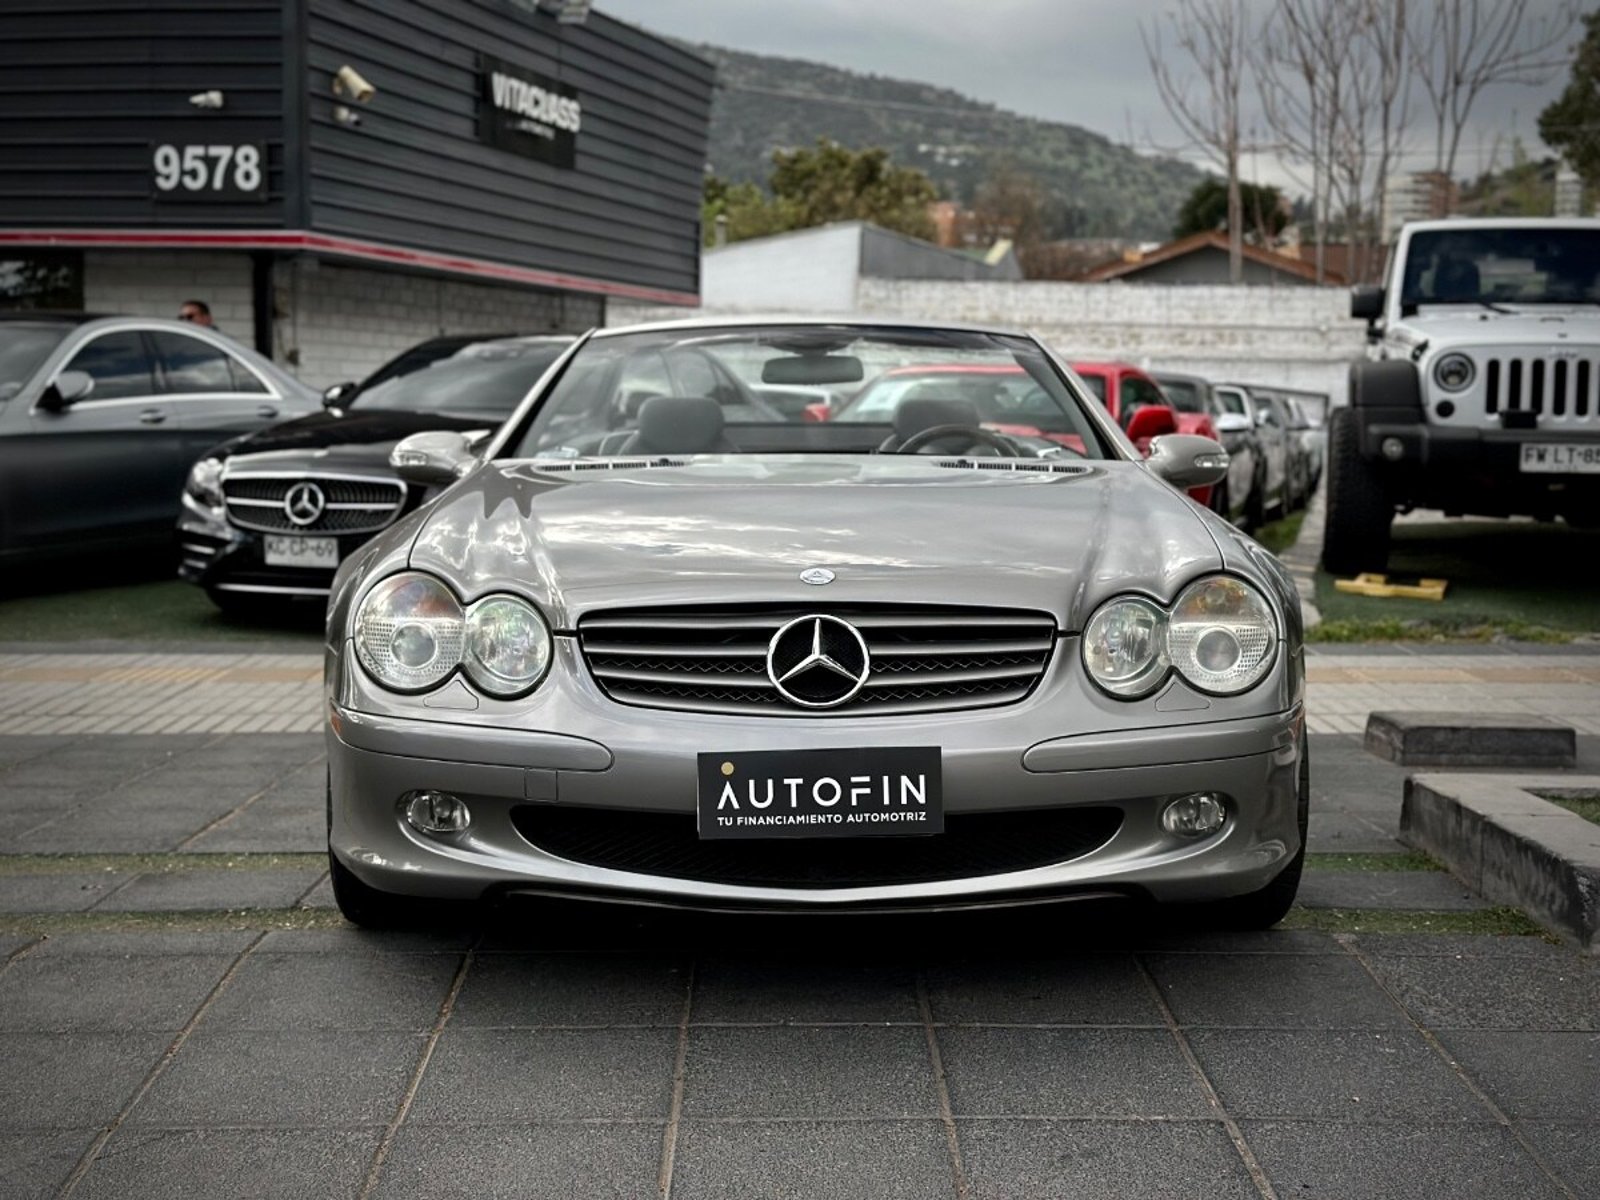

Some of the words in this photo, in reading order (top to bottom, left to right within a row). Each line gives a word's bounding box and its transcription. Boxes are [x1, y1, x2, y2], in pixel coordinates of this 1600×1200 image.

[154, 144, 261, 191] 9578
[717, 774, 926, 809] AUTOFIN
[717, 816, 733, 826] TU
[737, 814, 842, 826] FINANCIAMIENTO
[847, 812, 926, 823] AUTOMOTRIZ
